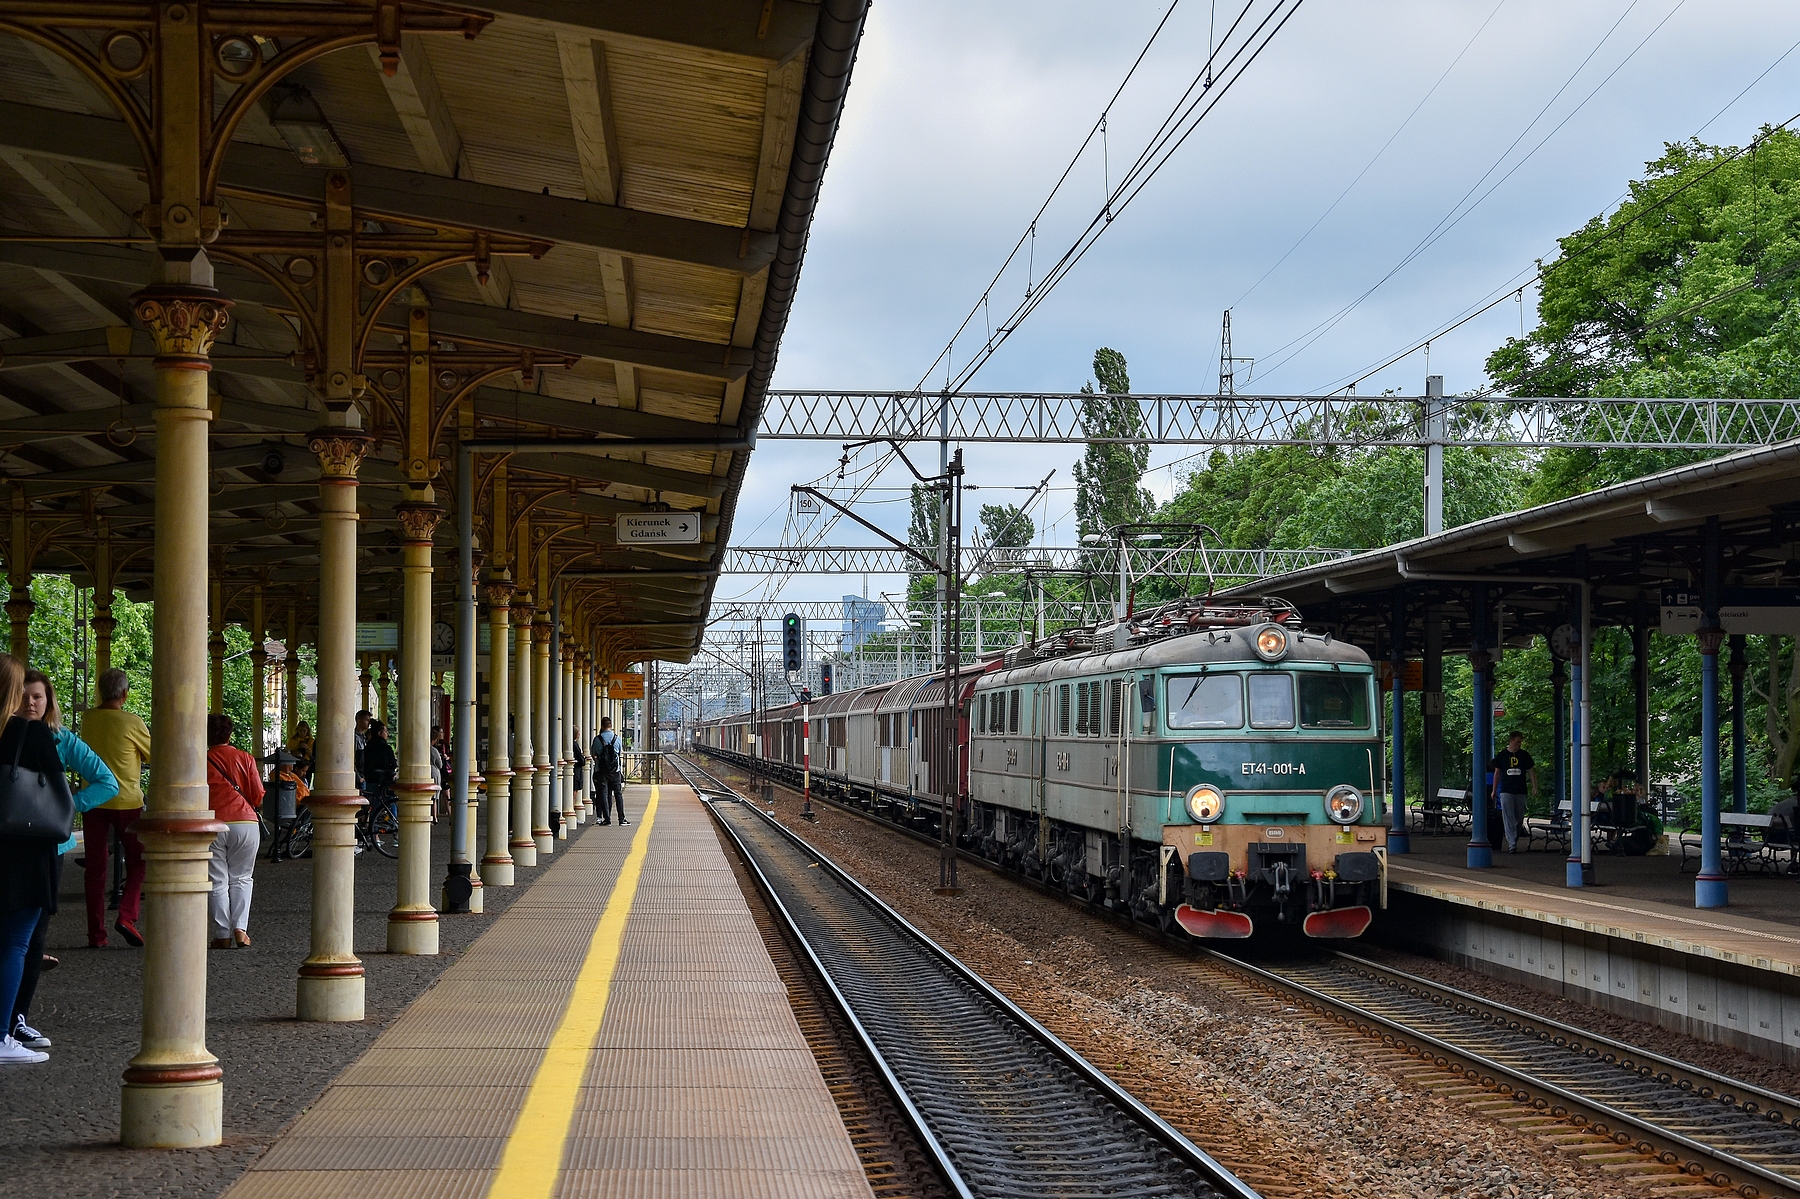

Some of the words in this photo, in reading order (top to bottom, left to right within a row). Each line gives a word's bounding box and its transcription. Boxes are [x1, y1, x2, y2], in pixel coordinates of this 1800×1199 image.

[800, 500, 812, 508] 150
[626, 518, 671, 526] Kierunek
[630, 529, 667, 538] Gdańsk
[1432, 692, 1440, 701] 11
[1241, 762, 1306, 775] ET41-001-A
